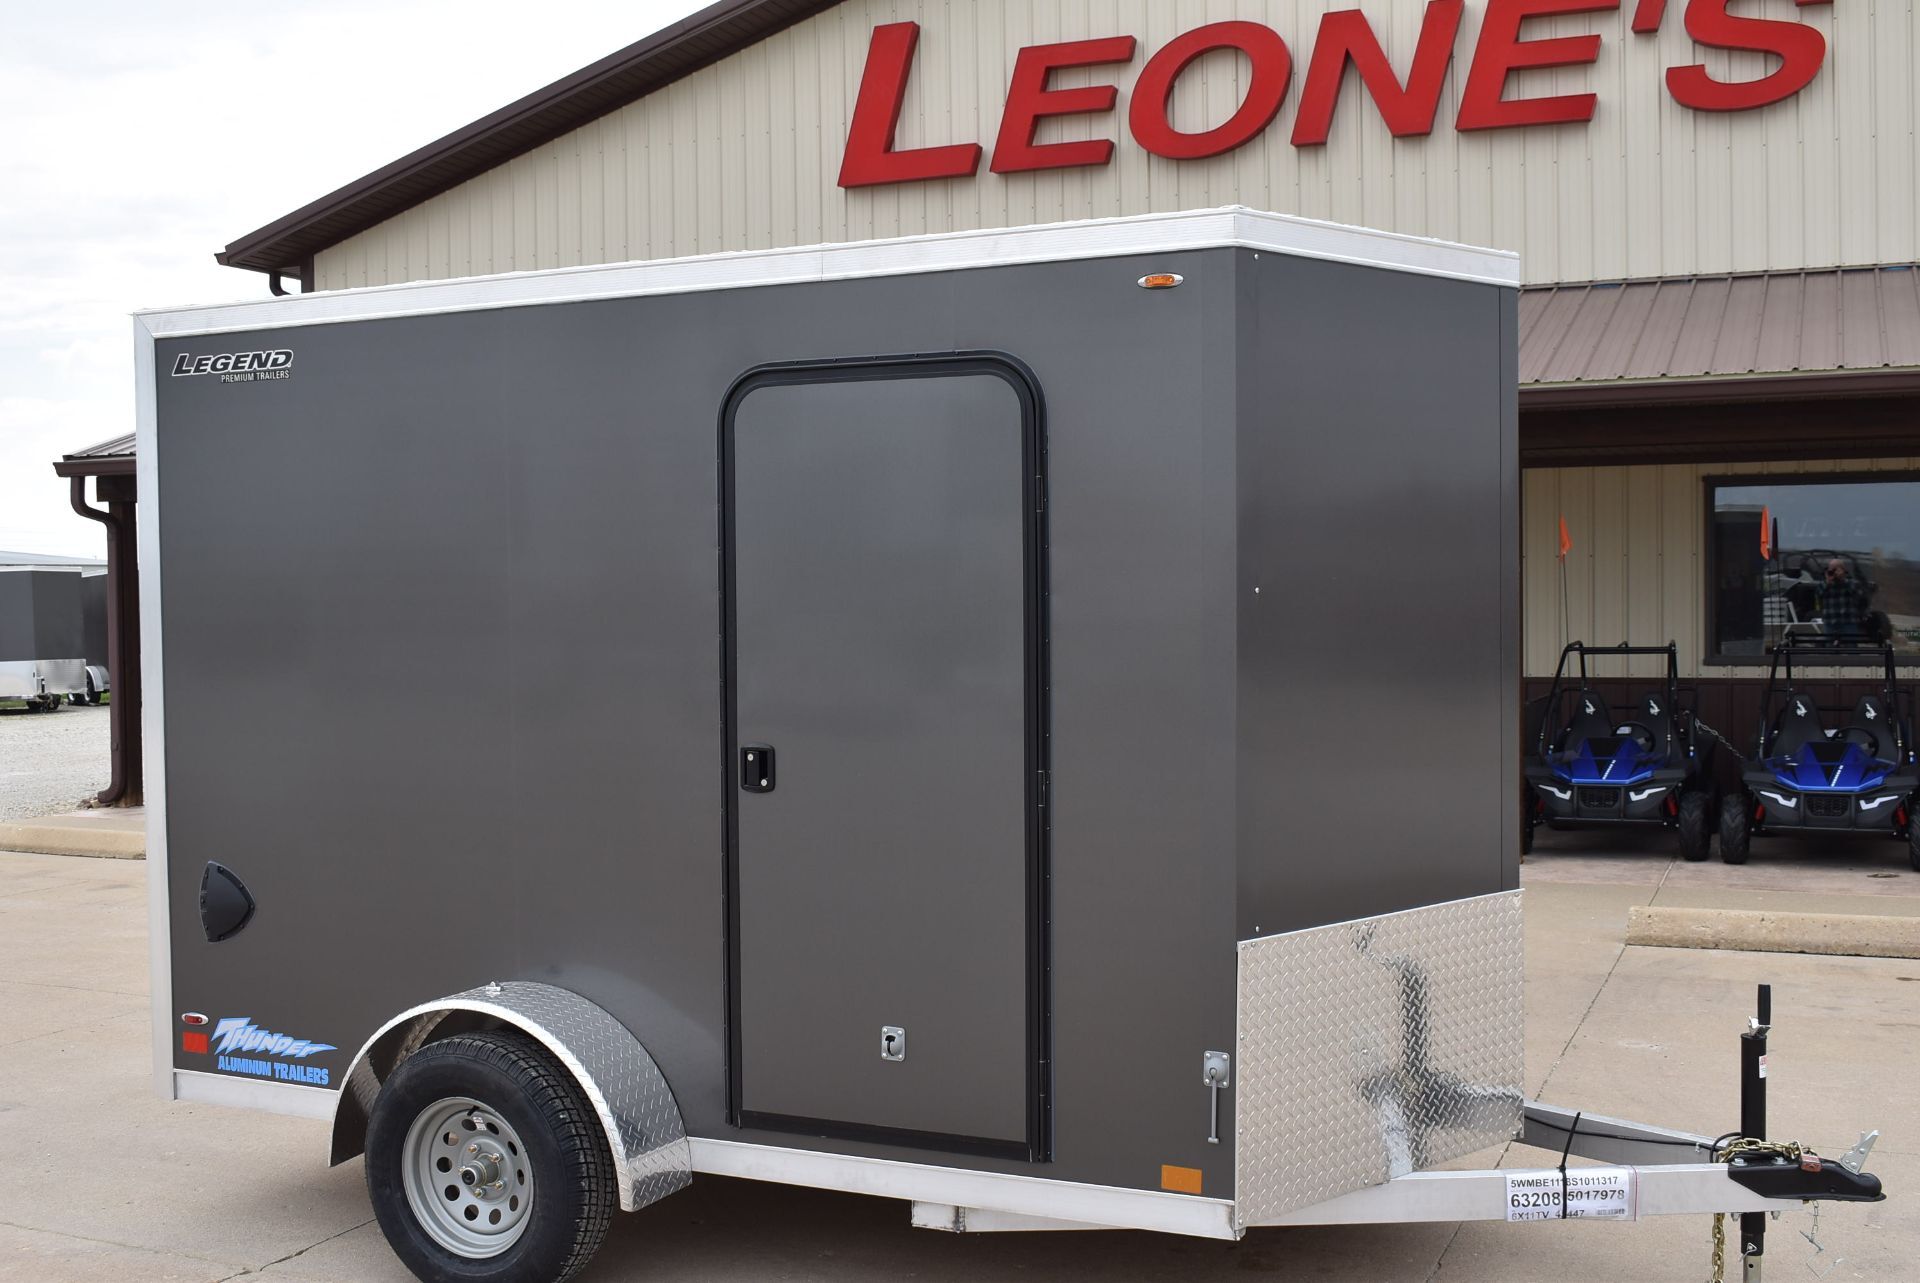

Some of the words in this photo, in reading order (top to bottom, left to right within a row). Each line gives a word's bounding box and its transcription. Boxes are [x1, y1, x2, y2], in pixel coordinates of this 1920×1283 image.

[838, 0, 1833, 188] LEONE'S
[172, 349, 293, 377] LEGEND
[221, 371, 254, 383] PREMIUM
[256, 370, 290, 380] TRAILERS
[211, 1017, 338, 1058] THUNDER
[218, 1056, 272, 1077] ALUMINUM
[274, 1062, 329, 1085] TRAILERS
[1511, 1176, 1618, 1188] 5WMBE118S1011317
[1511, 1192, 1561, 1208] 63208
[1567, 1189, 1625, 1202] 5017978
